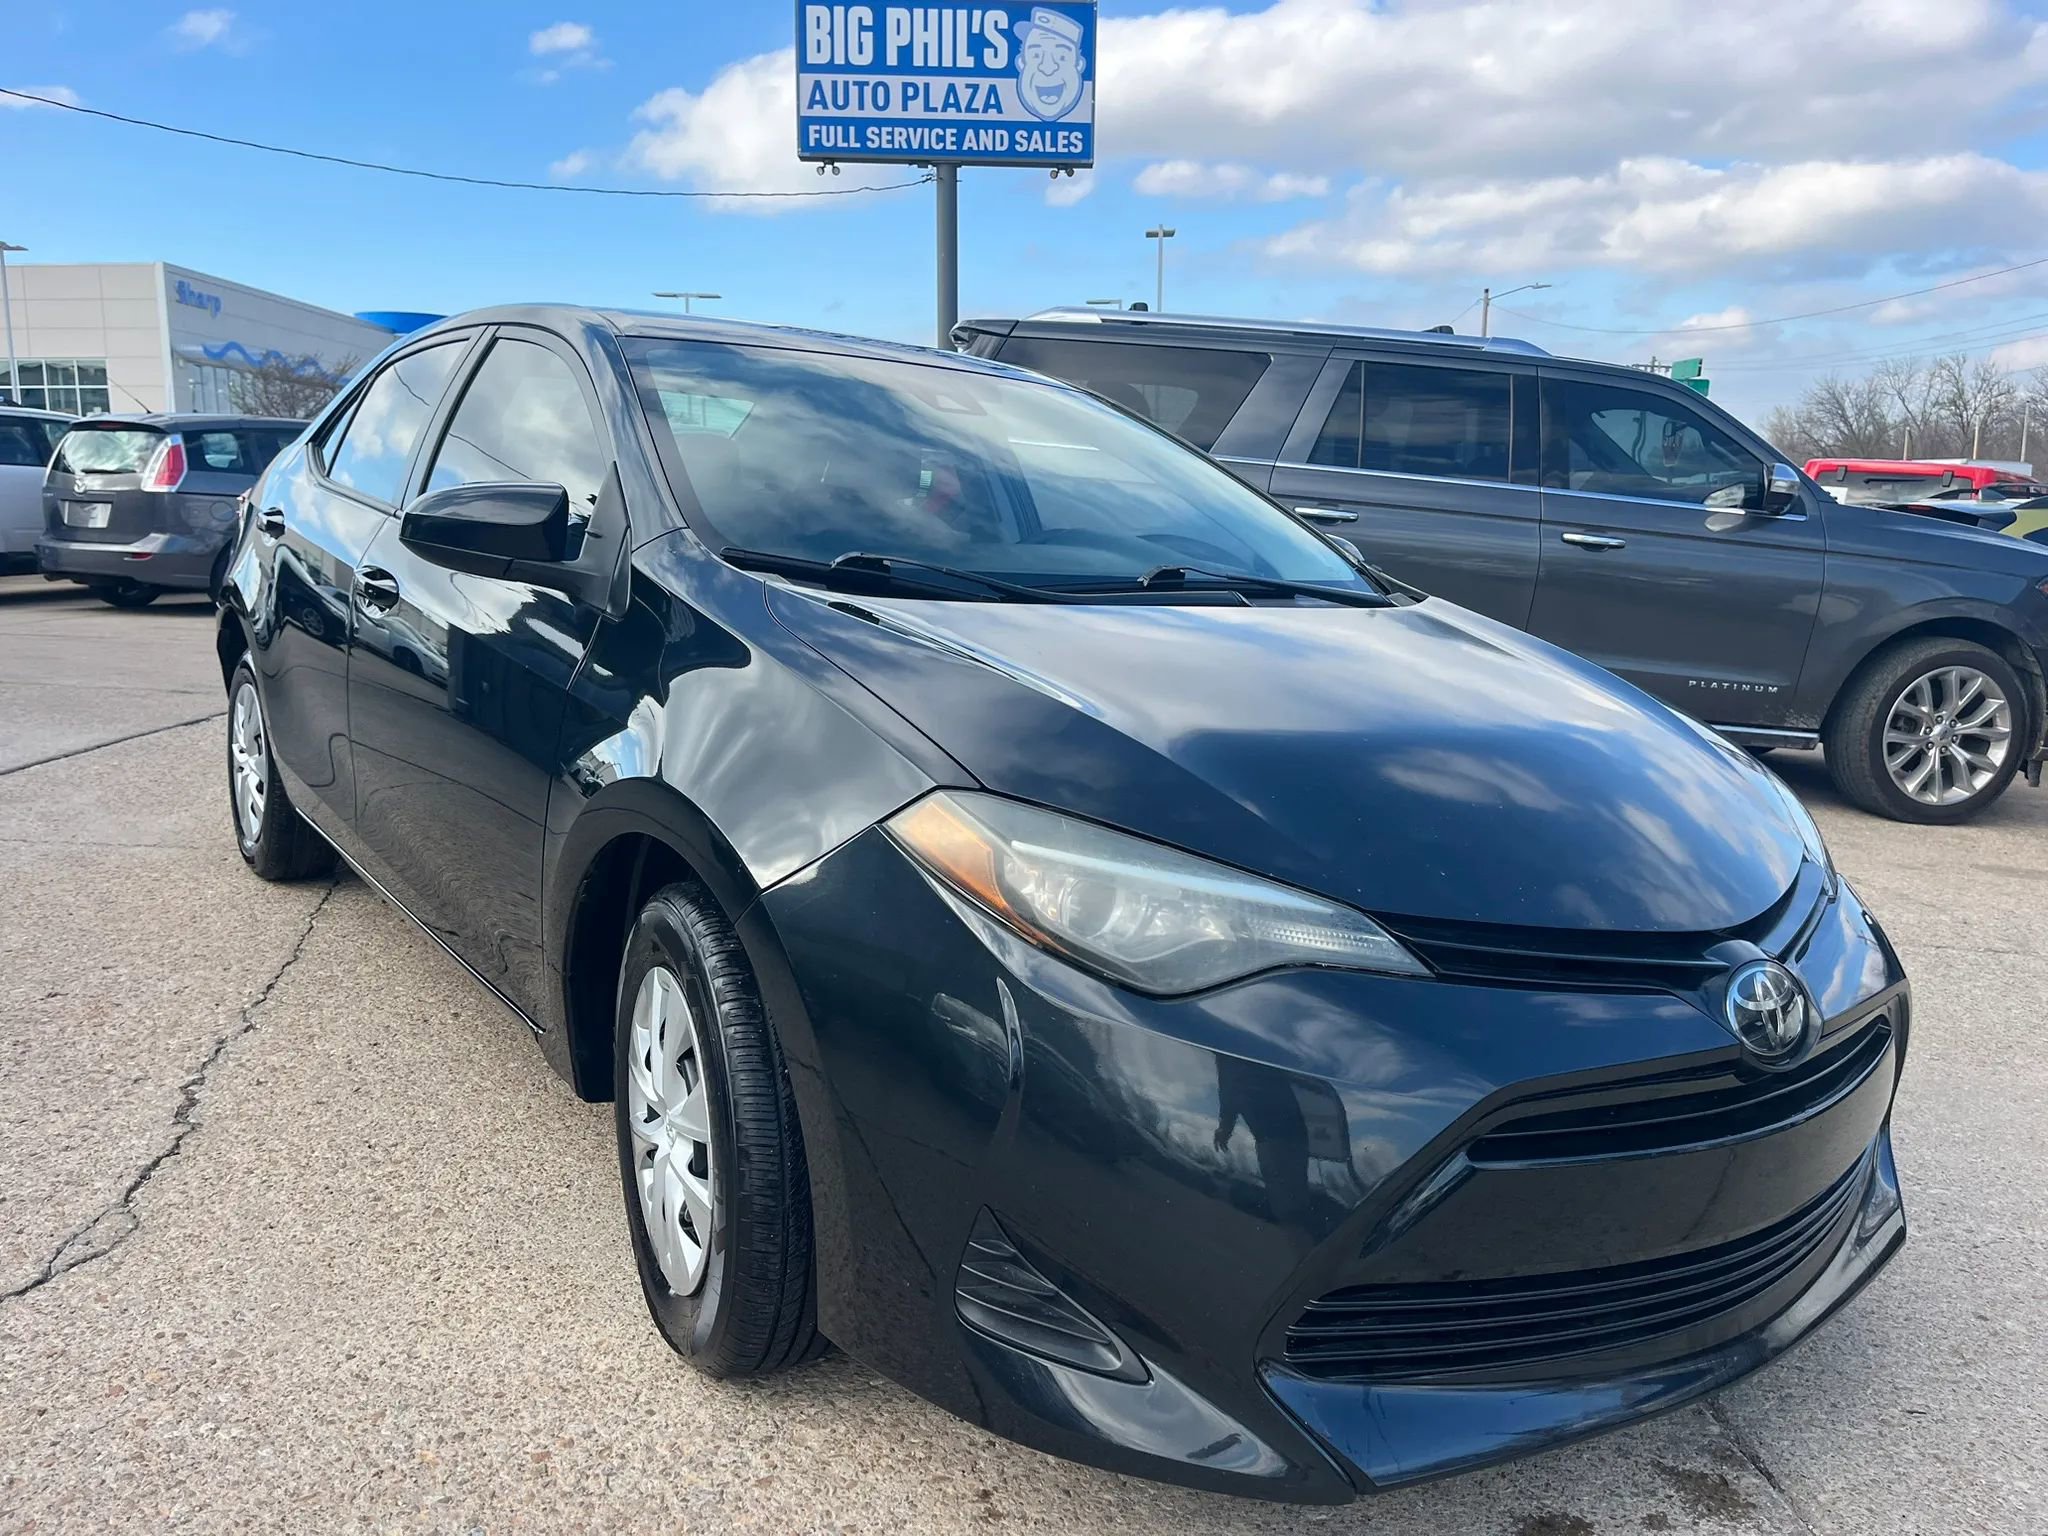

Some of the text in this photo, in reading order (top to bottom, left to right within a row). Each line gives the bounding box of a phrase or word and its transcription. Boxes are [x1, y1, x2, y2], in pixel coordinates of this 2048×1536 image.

[806, 5, 1009, 69] BIG PHIL'S
[806, 79, 1004, 115] AUTO PLAZA
[808, 124, 1083, 154] FULL SERVICE AND SALES
[176, 279, 223, 318] Sharp
[1688, 680, 1779, 693] PLATINUM
